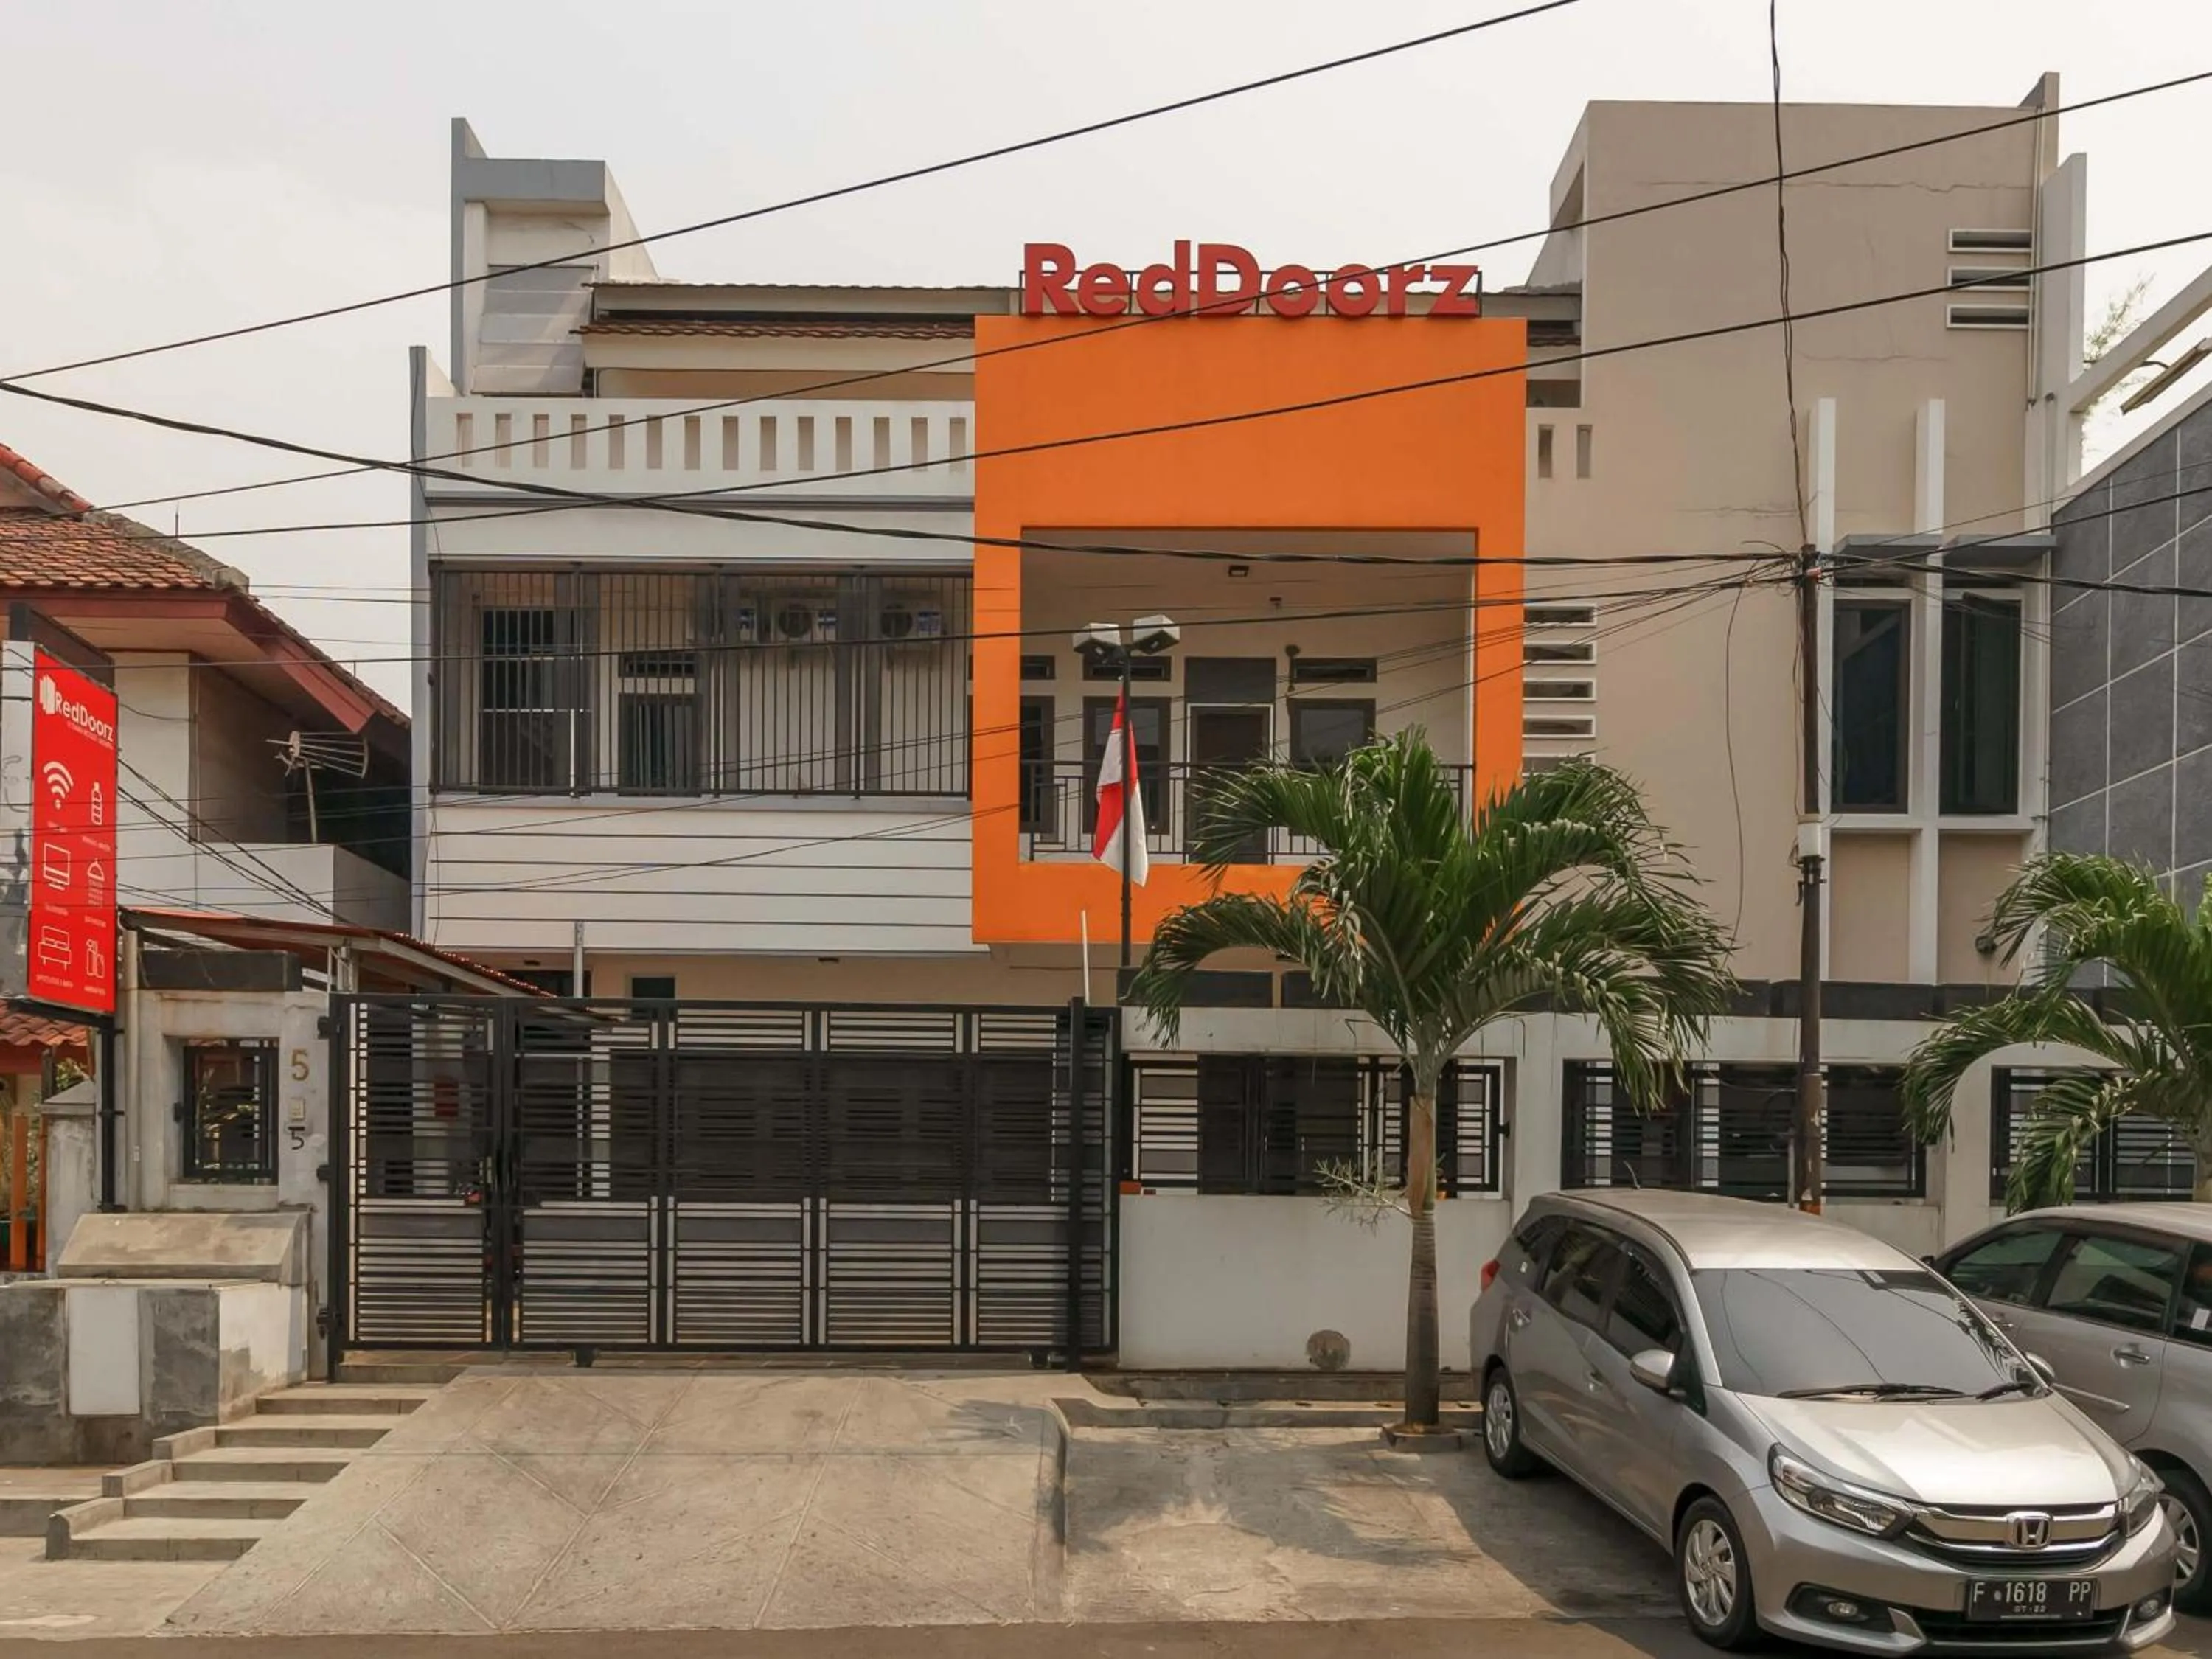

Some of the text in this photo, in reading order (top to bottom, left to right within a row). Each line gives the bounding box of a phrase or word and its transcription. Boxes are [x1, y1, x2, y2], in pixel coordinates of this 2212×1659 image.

[1023, 240, 1478, 317] RedDoorz
[55, 690, 114, 742] RedDoorz
[291, 1048, 310, 1081] 5
[288, 1126, 305, 1150] 5
[1973, 1582, 2091, 1603] F 1618 PP
